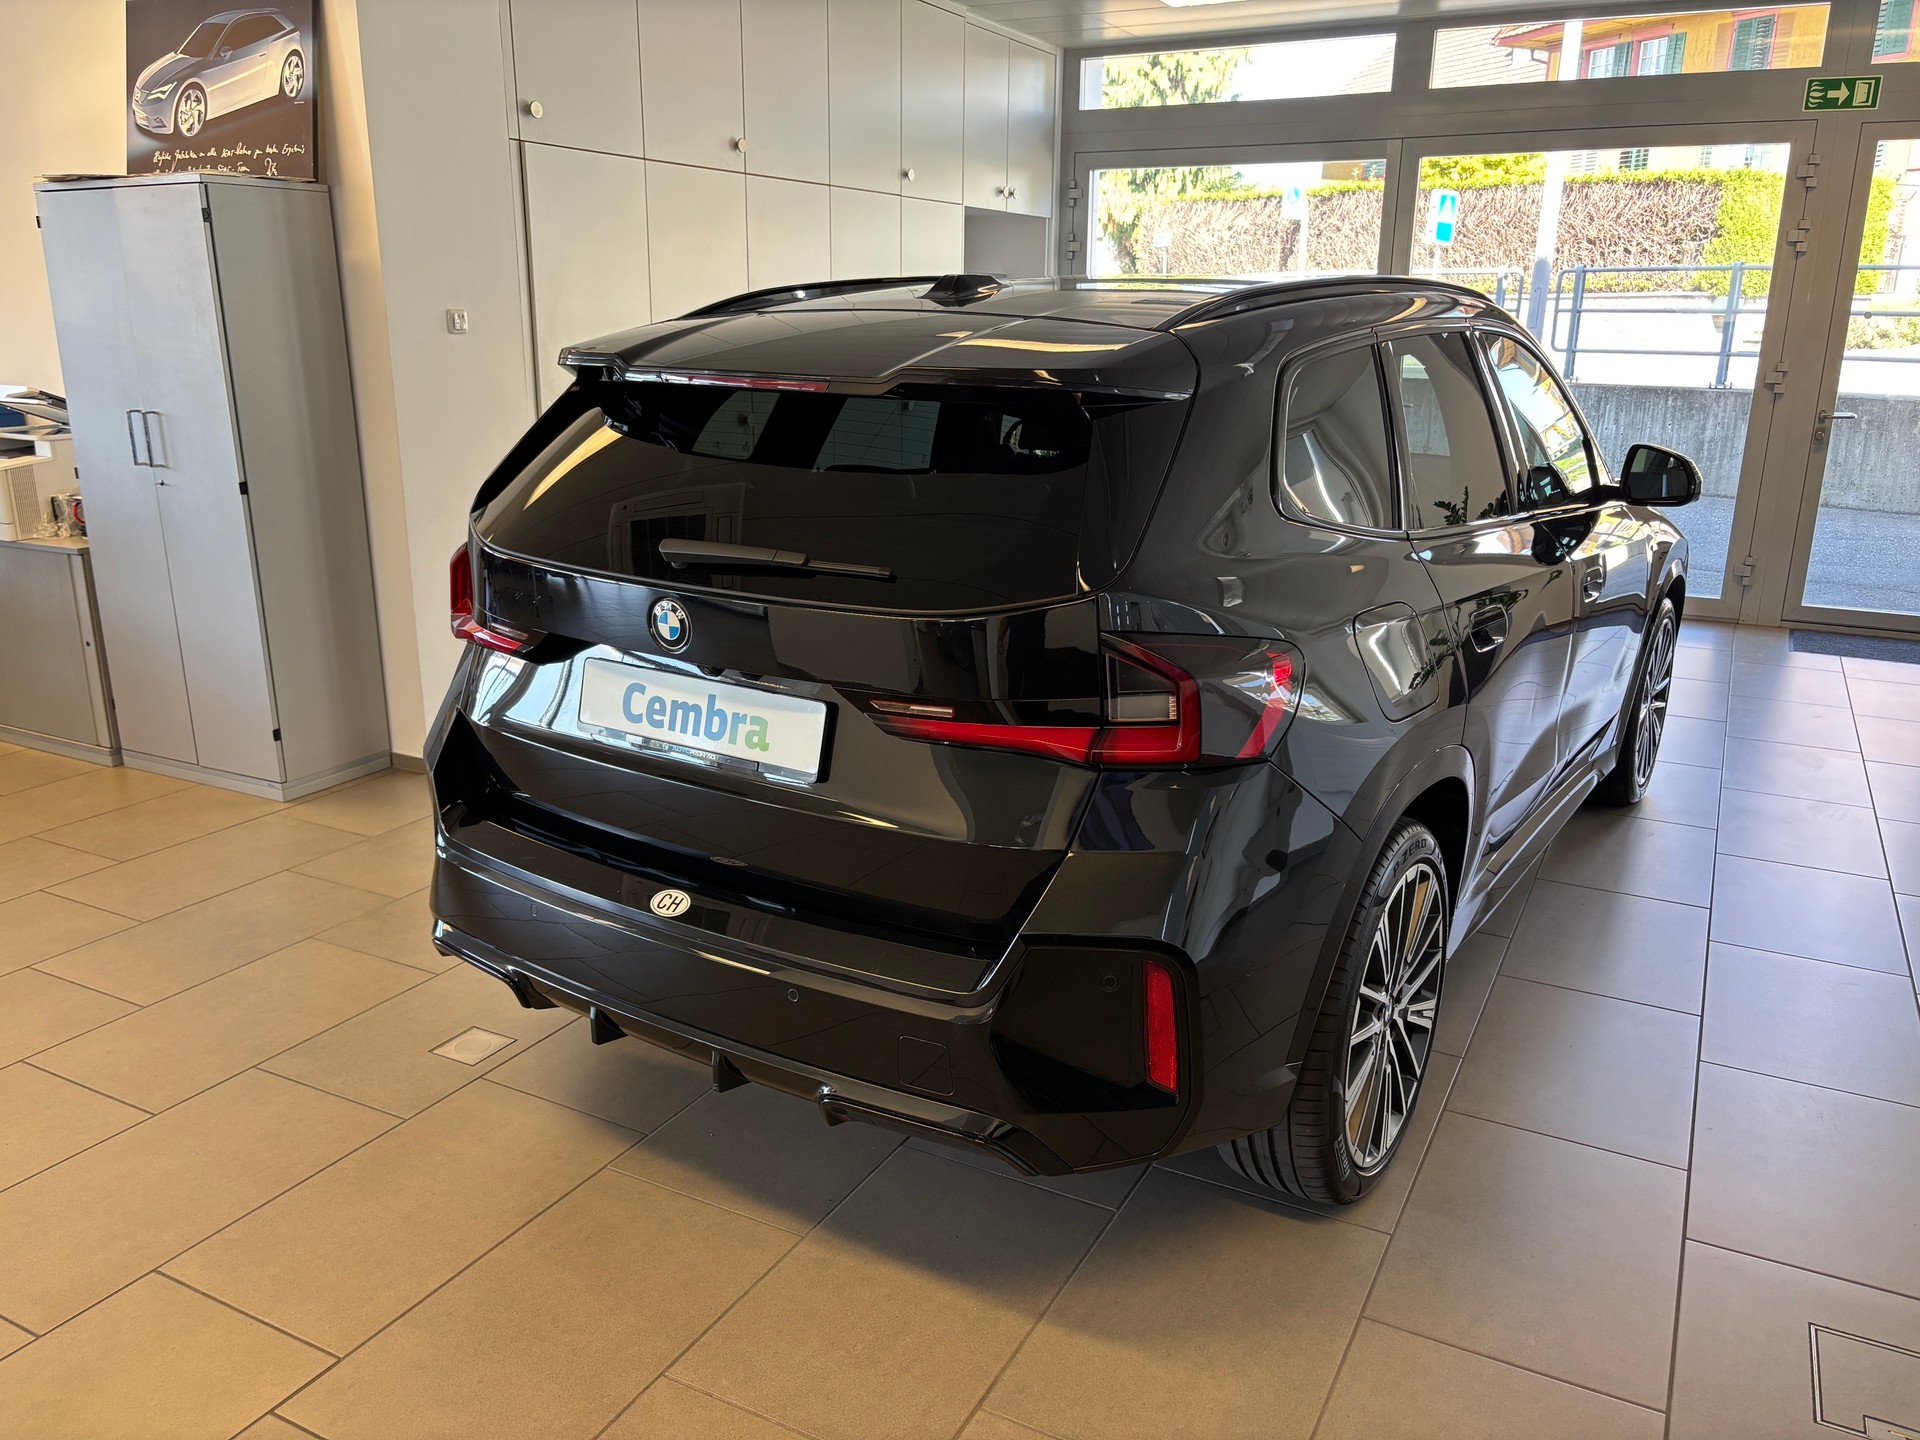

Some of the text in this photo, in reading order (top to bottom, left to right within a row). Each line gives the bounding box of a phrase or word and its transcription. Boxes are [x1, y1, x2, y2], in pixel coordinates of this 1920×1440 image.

[654, 601, 685, 620] BMW
[621, 682, 770, 752] Cembra
[1393, 860, 1400, 878] P
[1401, 838, 1427, 865] ZERO
[656, 893, 685, 913] CH
